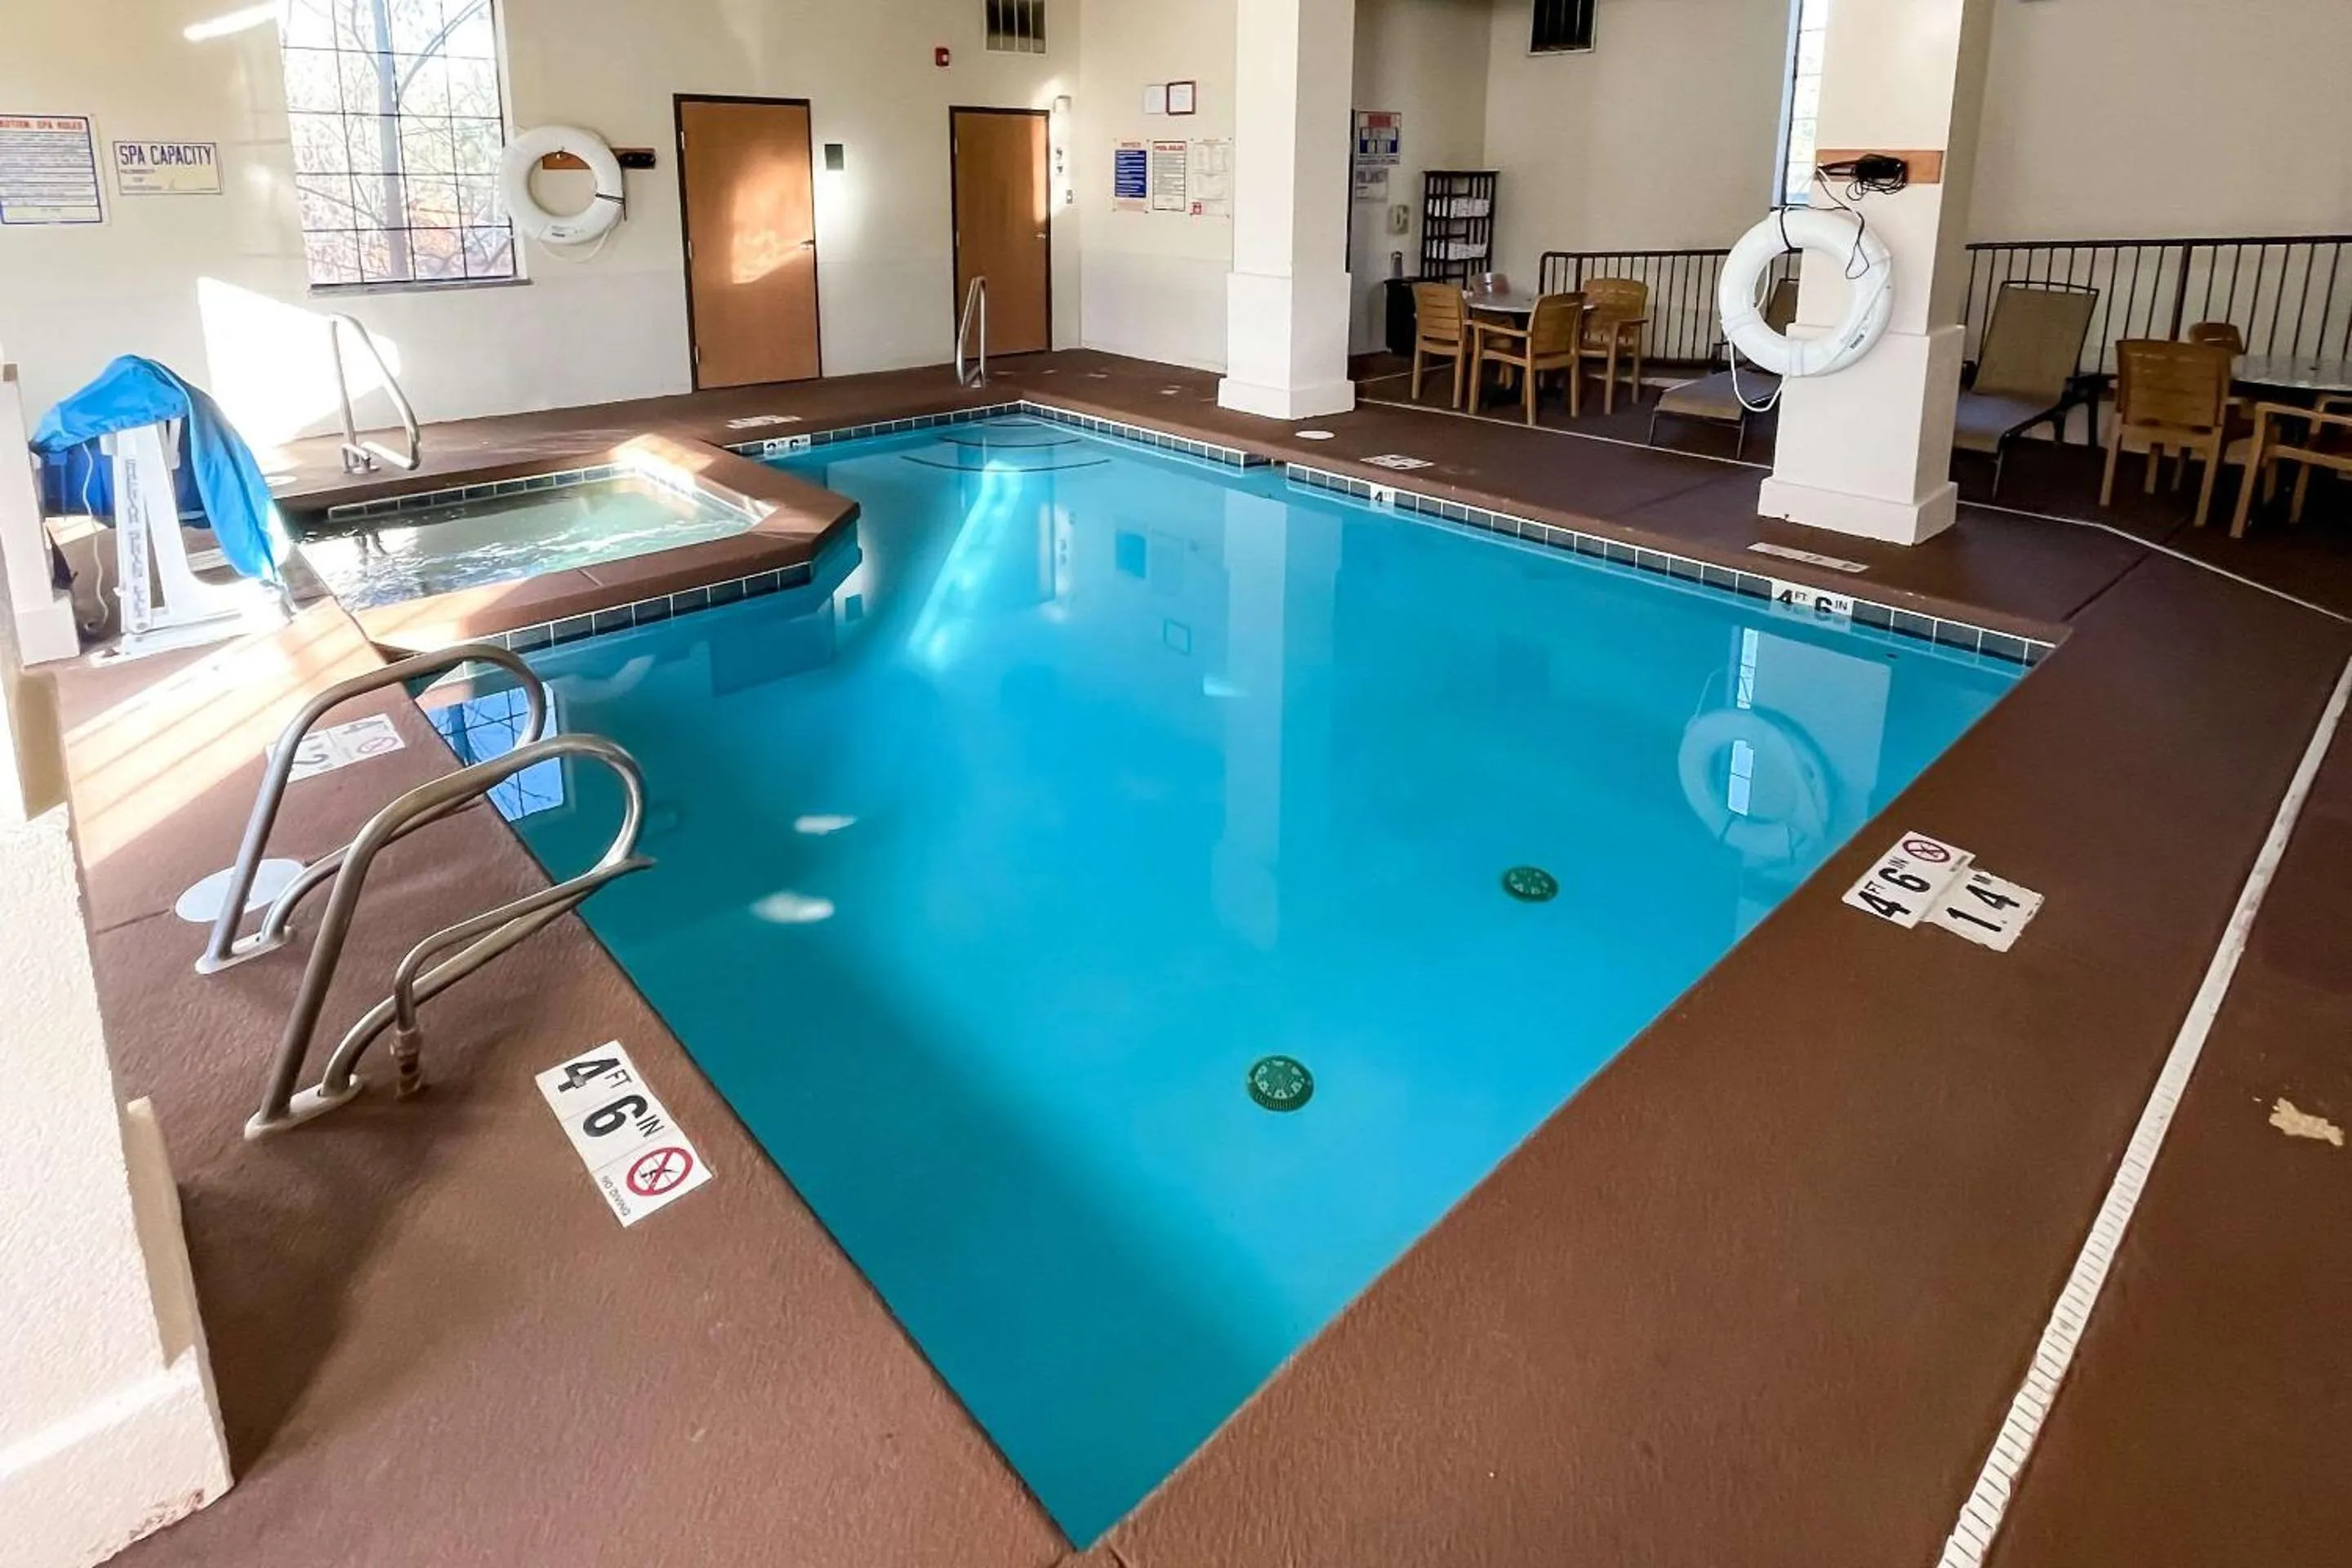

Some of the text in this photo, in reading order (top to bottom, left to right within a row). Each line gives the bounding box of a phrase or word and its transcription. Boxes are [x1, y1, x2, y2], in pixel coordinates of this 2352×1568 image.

[120, 145, 211, 166] SPA CAPACITY
[1776, 590, 1847, 613] 4 FT 6 IN
[1878, 867, 1931, 893] 6
[1858, 890, 1912, 918] 4
[558, 1058, 665, 1138] 4 FT 6 IN
[602, 1176, 631, 1217] NO DIVING
